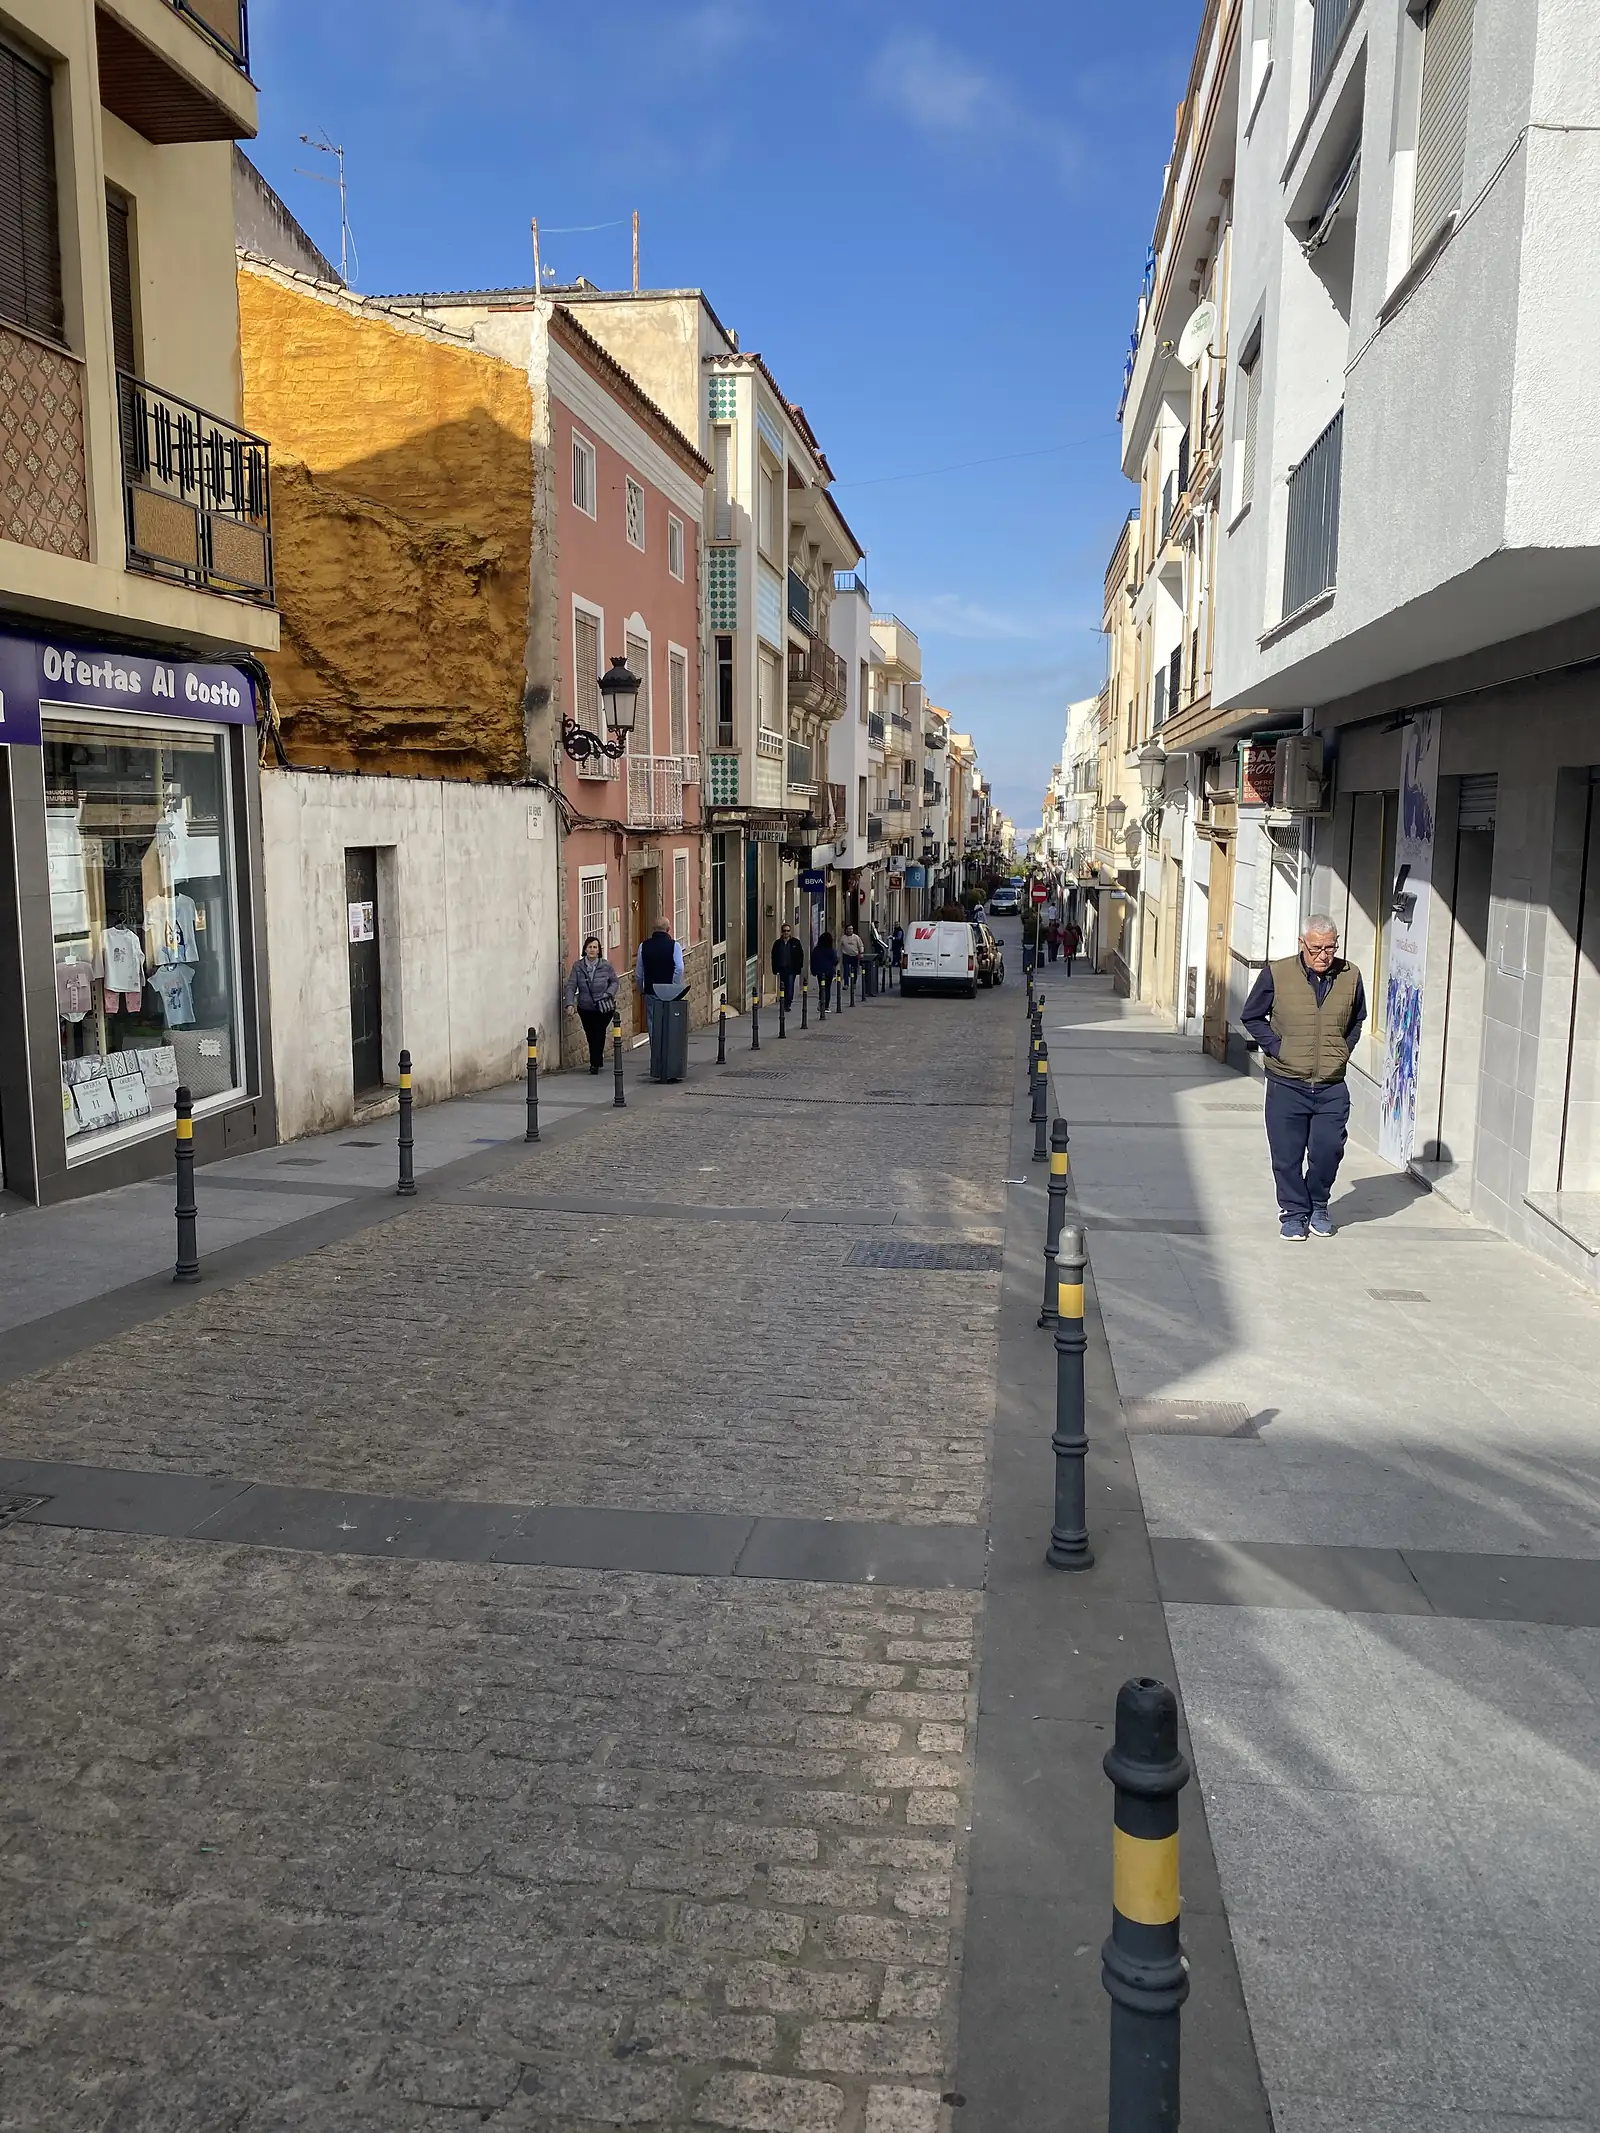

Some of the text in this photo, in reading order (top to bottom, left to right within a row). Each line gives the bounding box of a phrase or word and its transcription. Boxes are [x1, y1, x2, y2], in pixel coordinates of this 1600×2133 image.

[44, 646, 240, 708] Ofertas Al Costo
